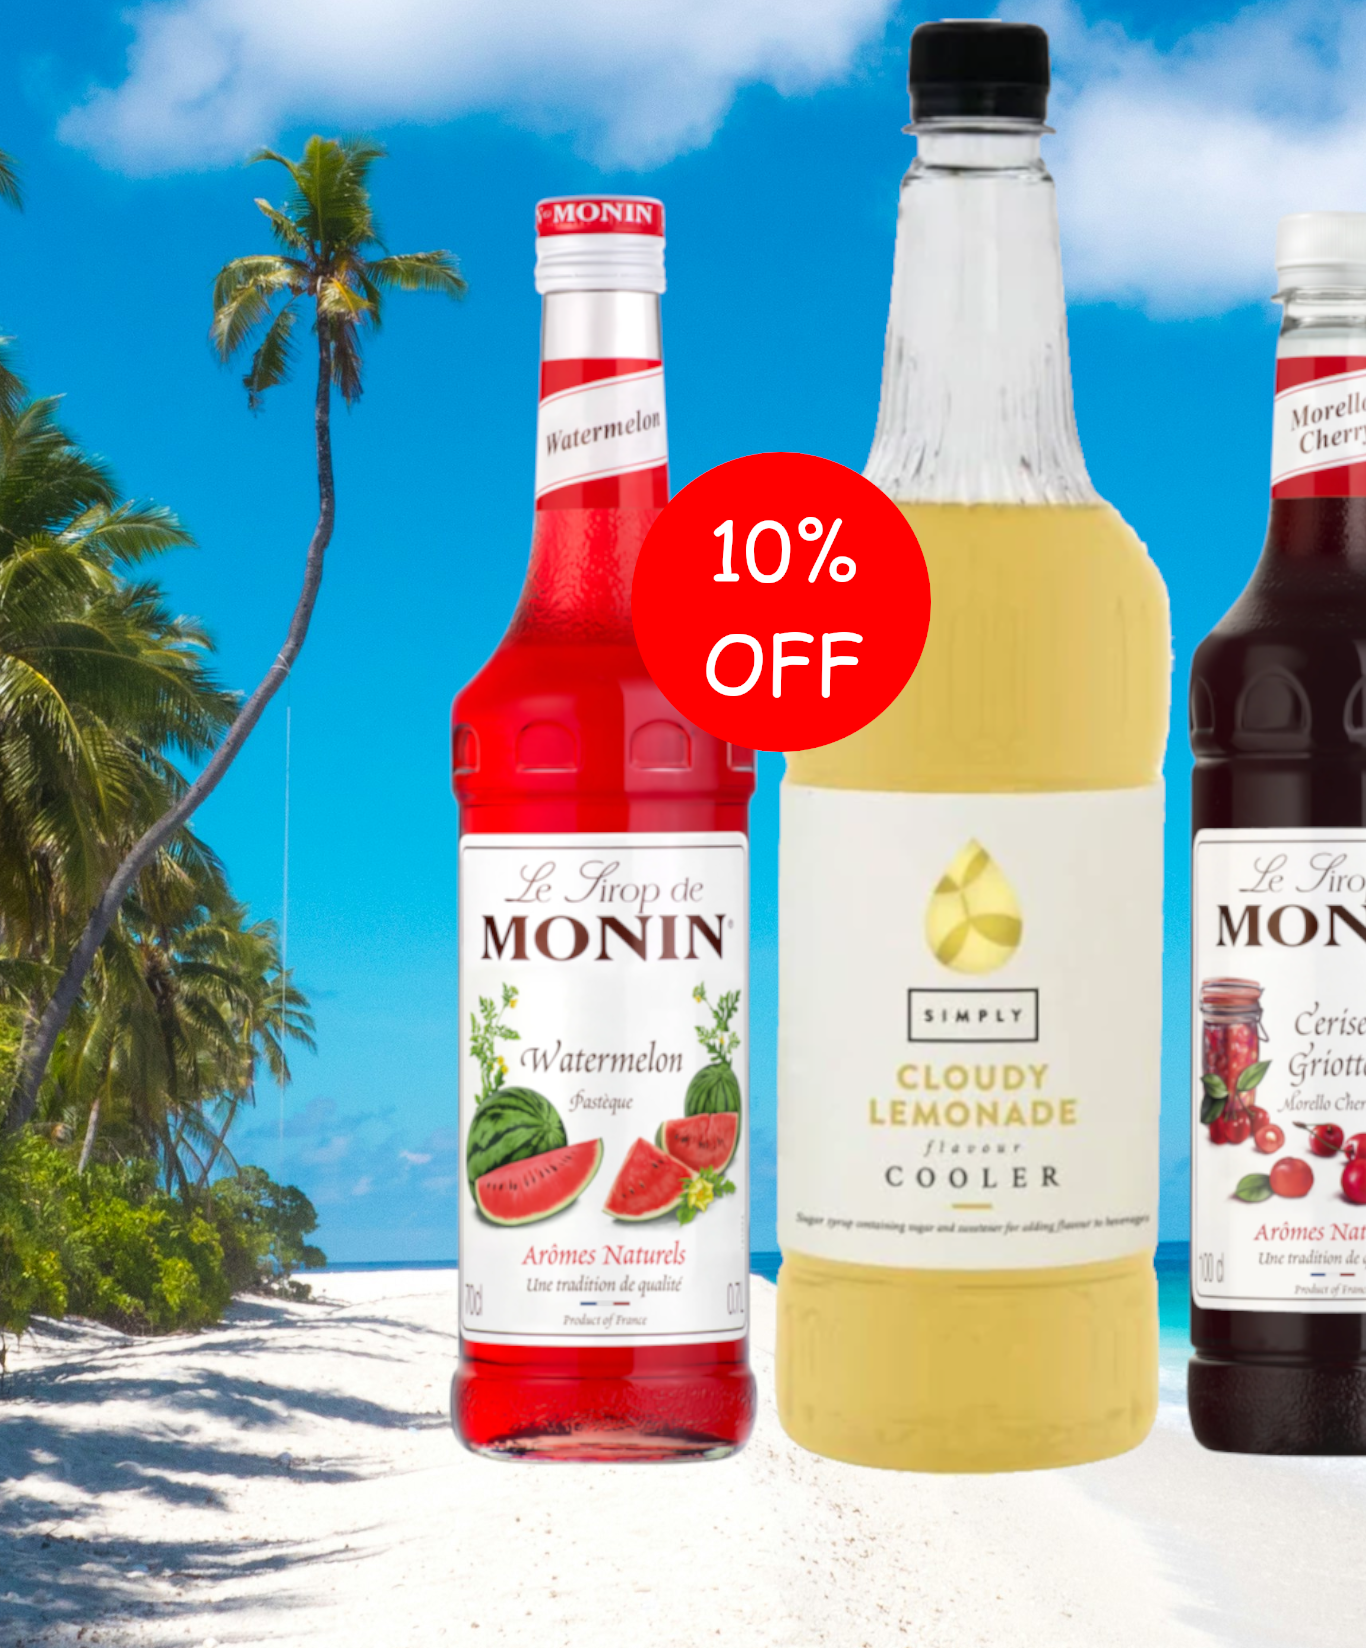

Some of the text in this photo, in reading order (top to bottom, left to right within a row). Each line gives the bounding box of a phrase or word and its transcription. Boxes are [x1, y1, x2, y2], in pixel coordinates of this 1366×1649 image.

[553, 203, 653, 224] MONIN
[546, 410, 661, 456] Watermelon
[1239, 853, 1287, 893] Le
[504, 860, 703, 913] Le Sirop de
[481, 914, 726, 962] MONIN
[924, 1008, 1024, 1023] SIMPLY
[520, 1039, 684, 1073] Watermelon
[897, 1063, 1049, 1091] CLOUDY
[568, 1089, 634, 1115] Pastèque
[869, 1098, 1078, 1127] LEMONADE
[1277, 1089, 1331, 1113] Morello
[924, 1139, 1022, 1157] flavour
[885, 1165, 1060, 1189] COOLER
[1254, 1221, 1324, 1242] Arômes
[521, 1240, 686, 1266] Arômes Naturels
[1258, 1251, 1285, 1265] Une
[1287, 1249, 1342, 1265] tradition
[1345, 1249, 1360, 1265] de
[526, 1274, 683, 1298] Une tradition de qualité
